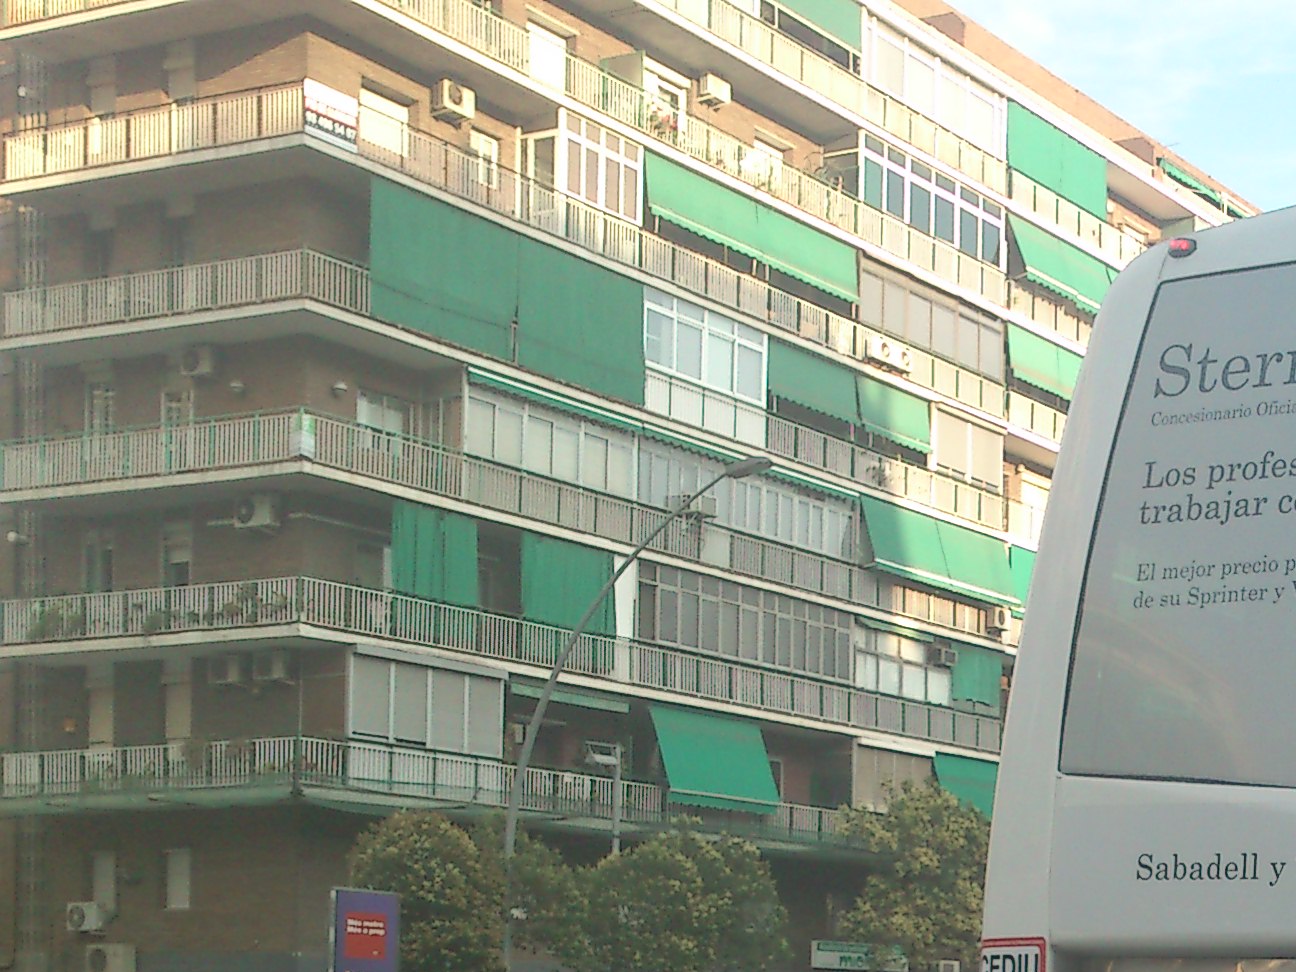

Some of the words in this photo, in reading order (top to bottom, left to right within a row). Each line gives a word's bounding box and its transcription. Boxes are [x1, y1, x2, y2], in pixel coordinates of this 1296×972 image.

[1151, 405, 1252, 427] Concesionario
[1142, 460, 1196, 489] Los
[1139, 492, 1268, 526] trabajar
[1137, 562, 1157, 583] El
[1162, 560, 1215, 583] mejor
[1219, 554, 1279, 581] precio
[1133, 589, 1155, 610] de
[1158, 590, 1182, 608] su
[1186, 583, 1267, 610] Sprinter
[1272, 586, 1285, 602] y
[1136, 852, 1260, 881] Sabadell
[1268, 861, 1287, 887] y
